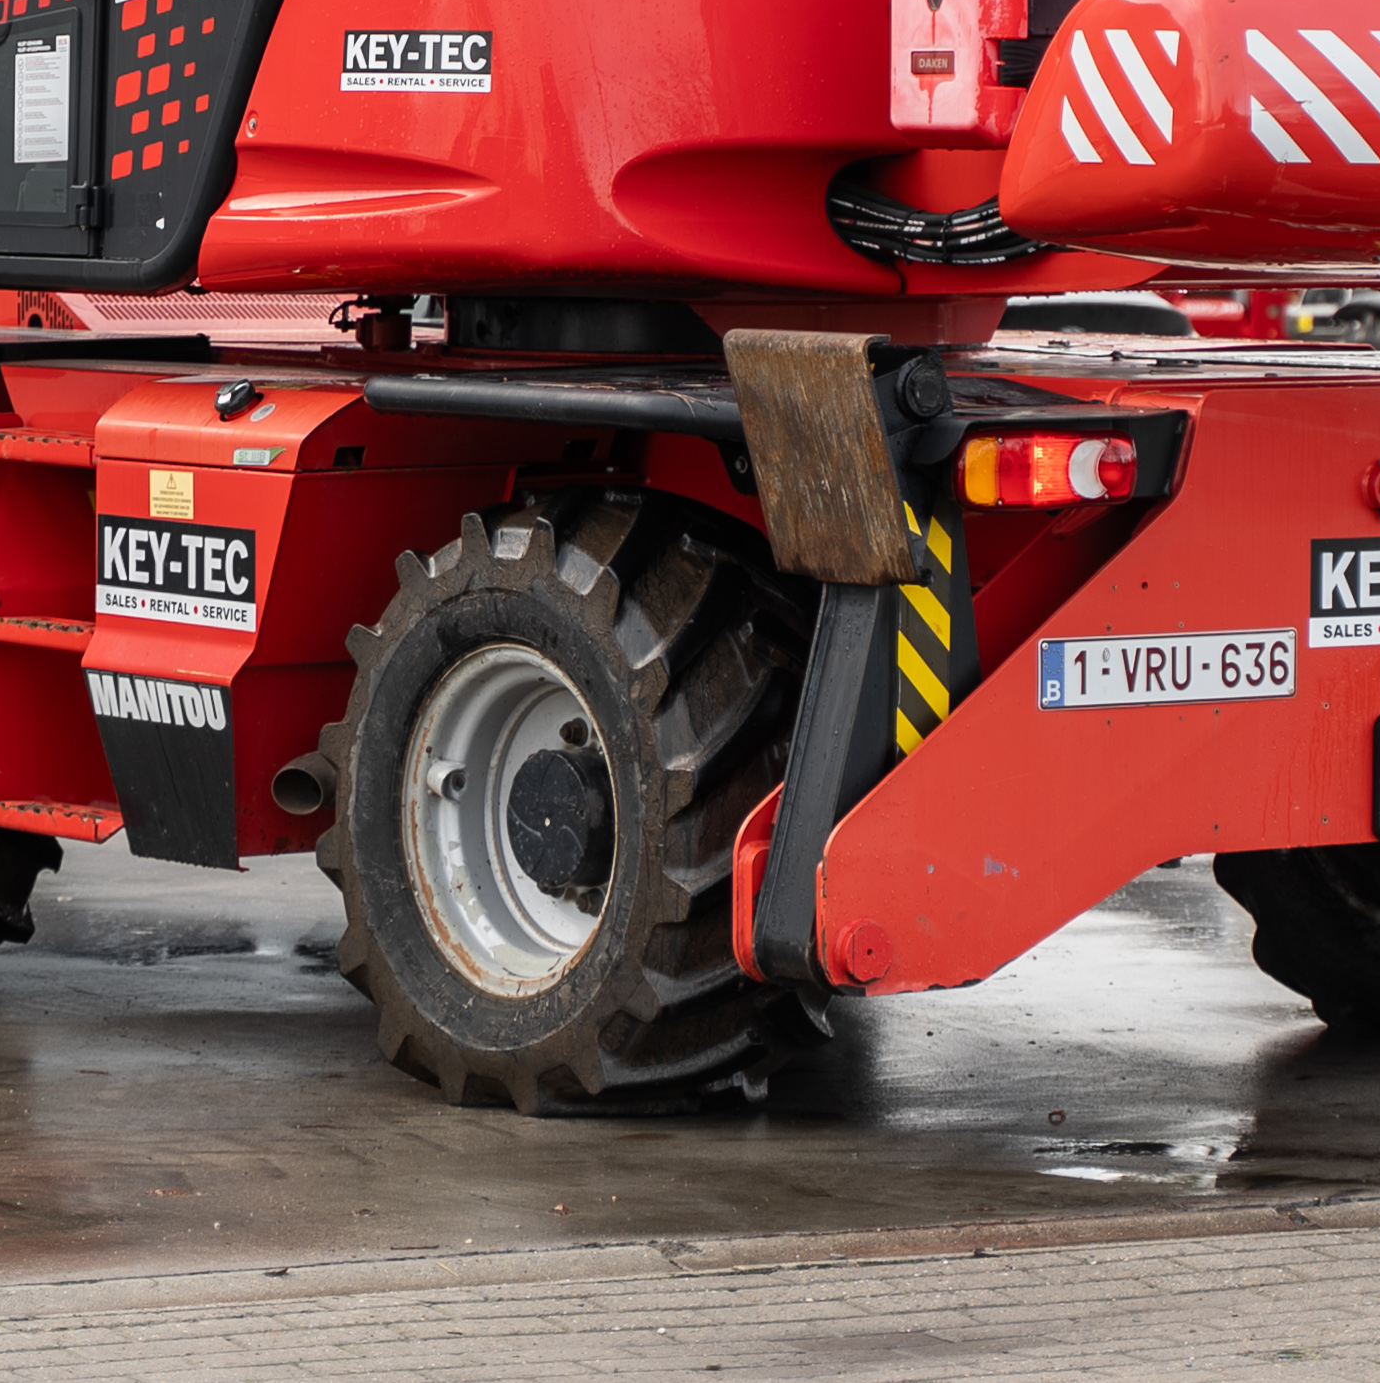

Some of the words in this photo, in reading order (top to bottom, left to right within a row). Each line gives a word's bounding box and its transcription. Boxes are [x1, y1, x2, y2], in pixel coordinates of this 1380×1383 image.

[345, 33, 487, 71] KEY-TEC
[918, 57, 949, 69] DAKEN
[346, 76, 376, 86] SALES
[387, 77, 426, 87] RENTAL
[438, 78, 485, 88] SERVICE
[103, 525, 250, 596] KEY-TEC
[105, 593, 138, 609] SALES
[149, 598, 190, 616] RENTAL
[202, 604, 248, 623] SERVICE
[1323, 622, 1373, 639] SALES
[87, 672, 227, 731] MANITOU
[1046, 679, 1062, 702] B
